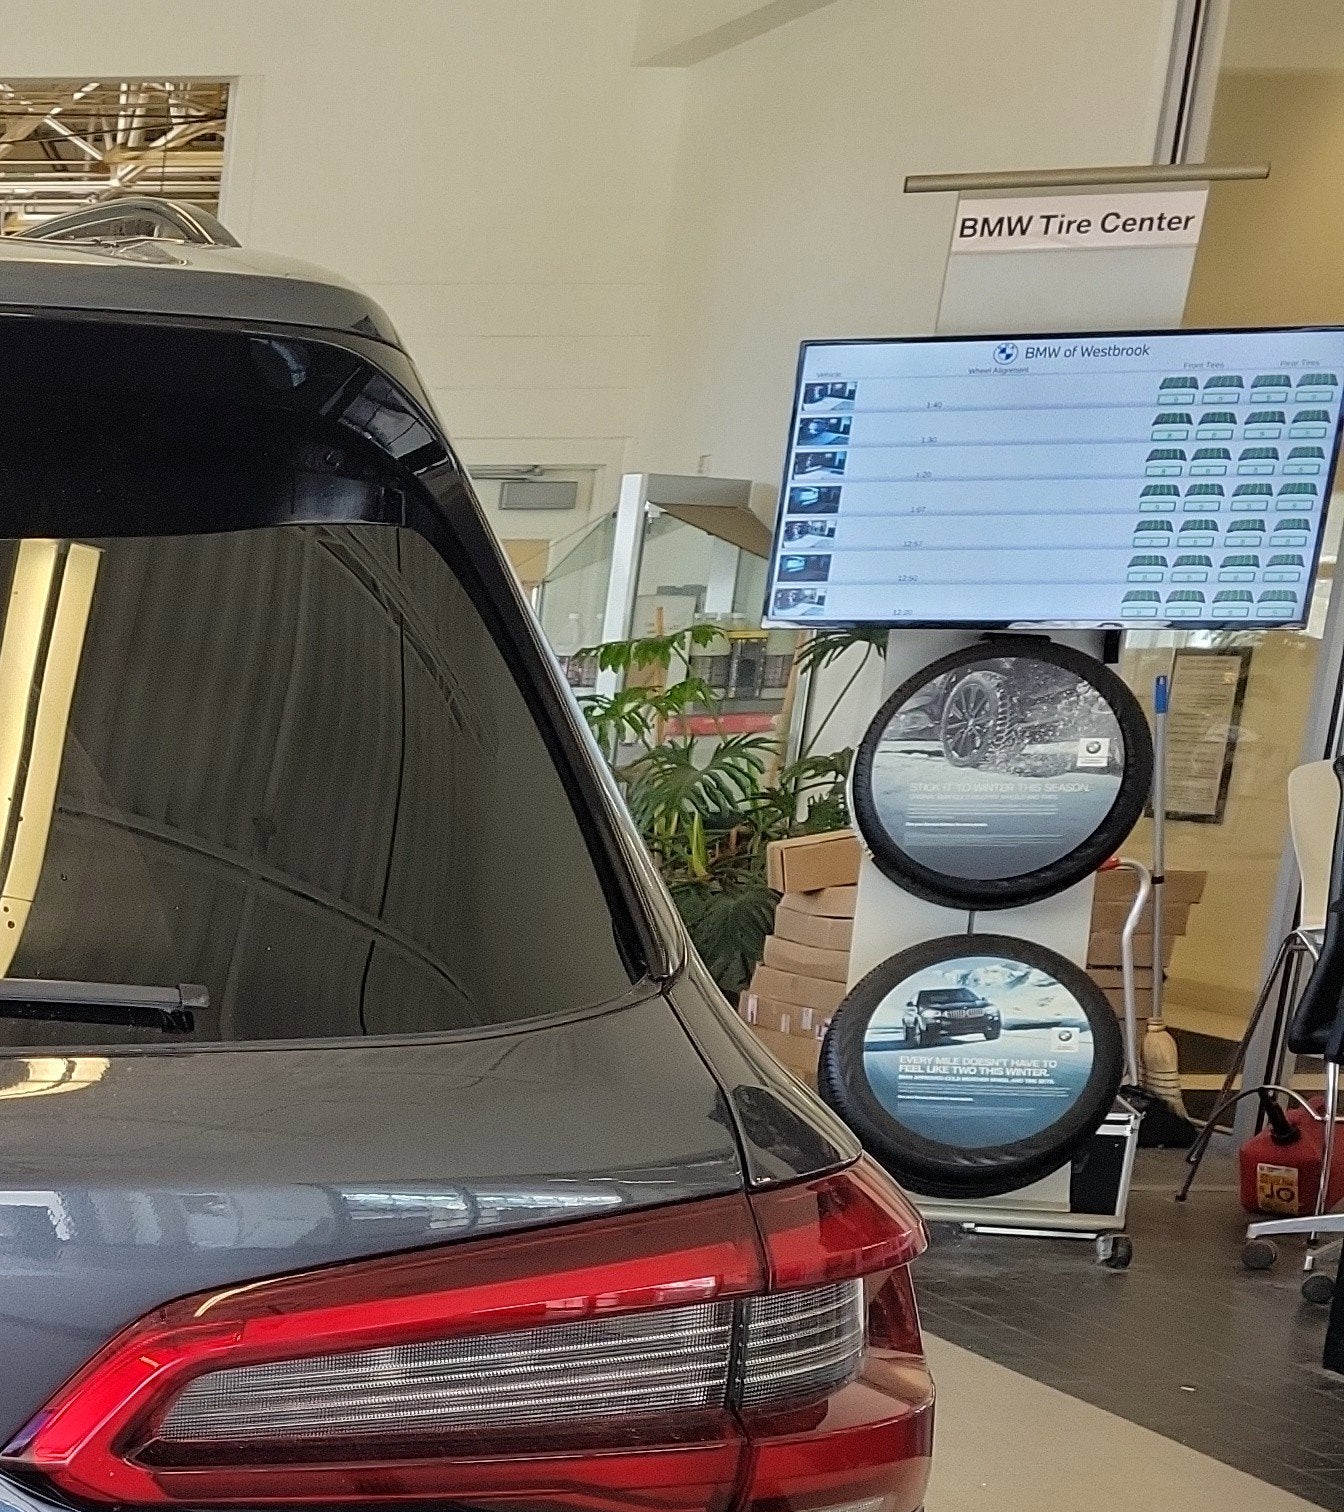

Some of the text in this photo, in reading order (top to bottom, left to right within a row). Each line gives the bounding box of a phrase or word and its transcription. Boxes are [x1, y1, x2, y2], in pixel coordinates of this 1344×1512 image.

[959, 211, 1196, 238] BMW Tire Center
[1025, 343, 1151, 360] BMW of Westbrook
[974, 783, 1014, 792] WINTER
[1018, 783, 1042, 792] THIS
[899, 1055, 1058, 1069] EVERY MILE DOESN'T HAVE TO
[898, 1065, 1050, 1077] FEEL LIKE TWO THIS WINTER.
